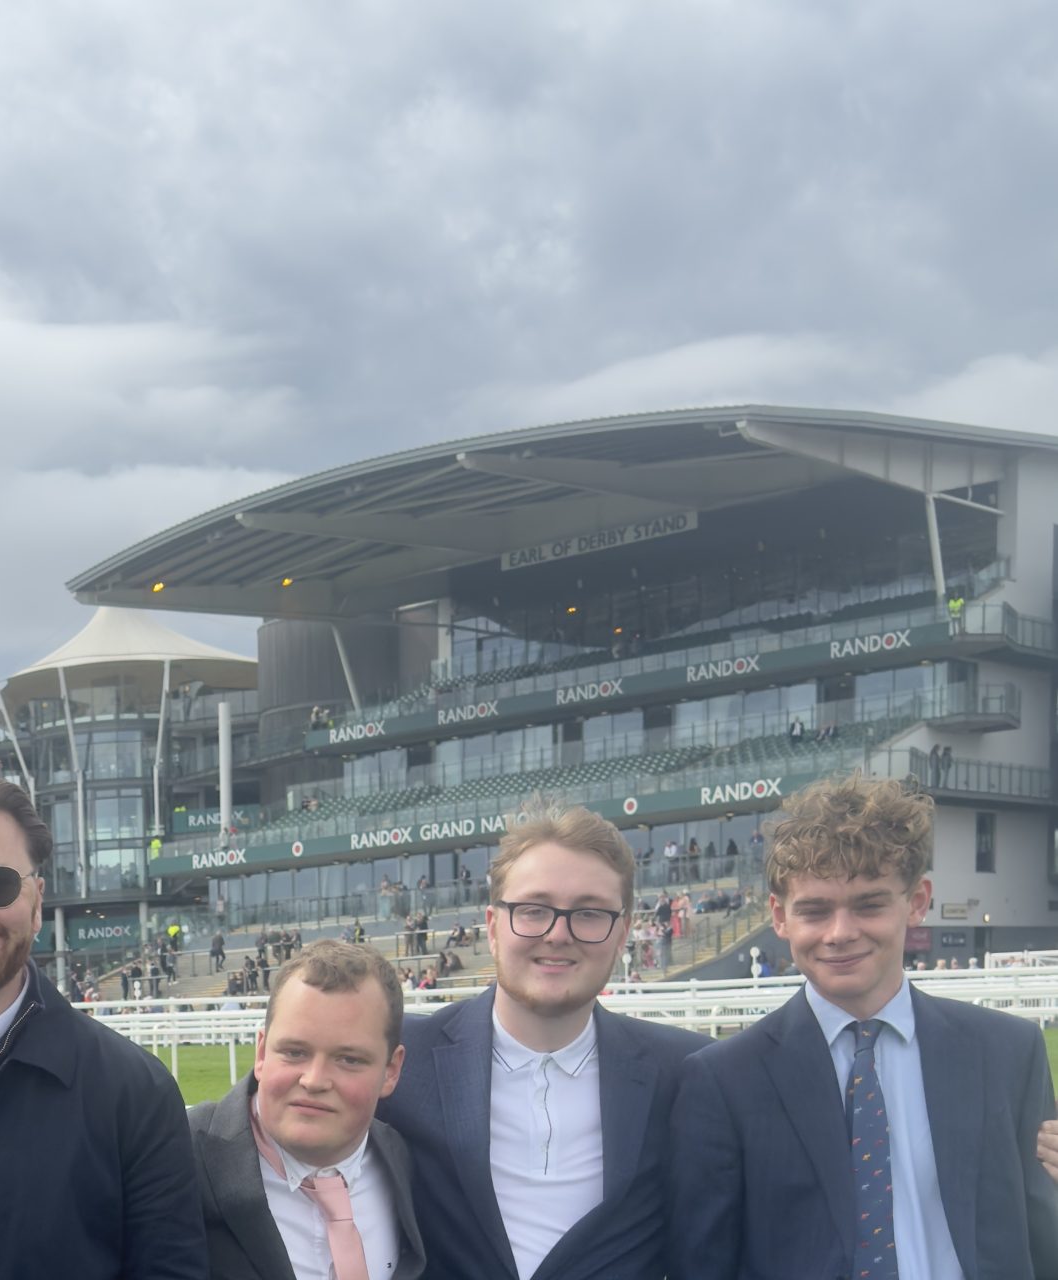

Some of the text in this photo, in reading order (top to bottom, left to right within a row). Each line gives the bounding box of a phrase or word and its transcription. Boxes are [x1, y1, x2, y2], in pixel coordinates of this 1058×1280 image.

[509, 515, 687, 567] EARL OF DERBY STAND
[830, 629, 911, 659] RANDOX
[686, 654, 760, 683] RANDOX
[556, 678, 623, 706] RANDOX
[437, 700, 499, 726] RANDOX
[329, 720, 386, 744] RANDOX
[700, 777, 782, 806] RANDOX
[188, 810, 244, 827] RANDX
[350, 827, 413, 850] RANDOX
[419, 819, 475, 841] GRAND
[192, 849, 246, 869] RANDOX
[78, 925, 131, 939] RANDOX
